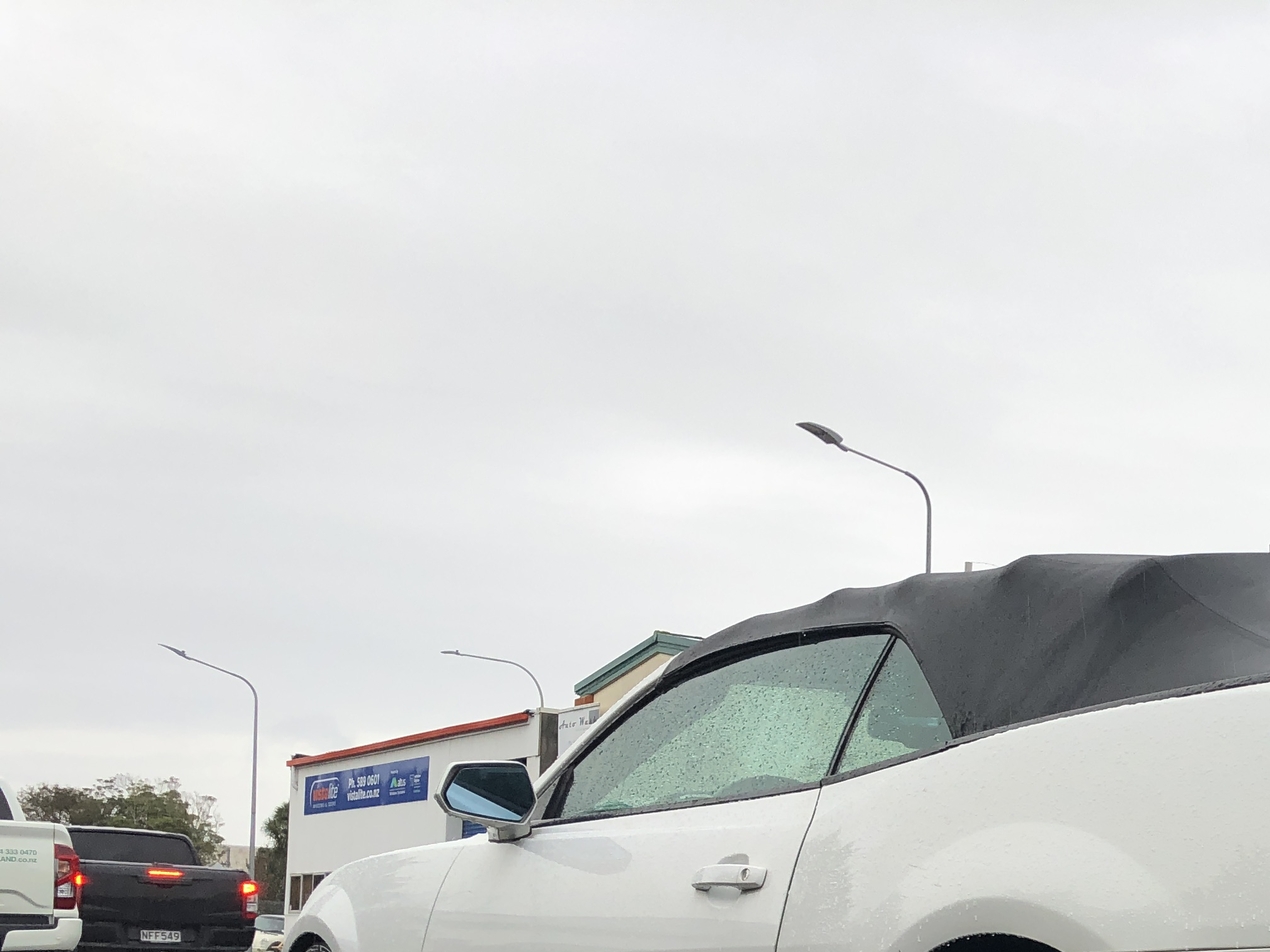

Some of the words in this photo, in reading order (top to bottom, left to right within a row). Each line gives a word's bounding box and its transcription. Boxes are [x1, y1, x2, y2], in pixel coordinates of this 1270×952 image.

[357, 775, 367, 788] 589
[367, 773, 380, 786] 0601
[141, 931, 180, 941] NFF549
